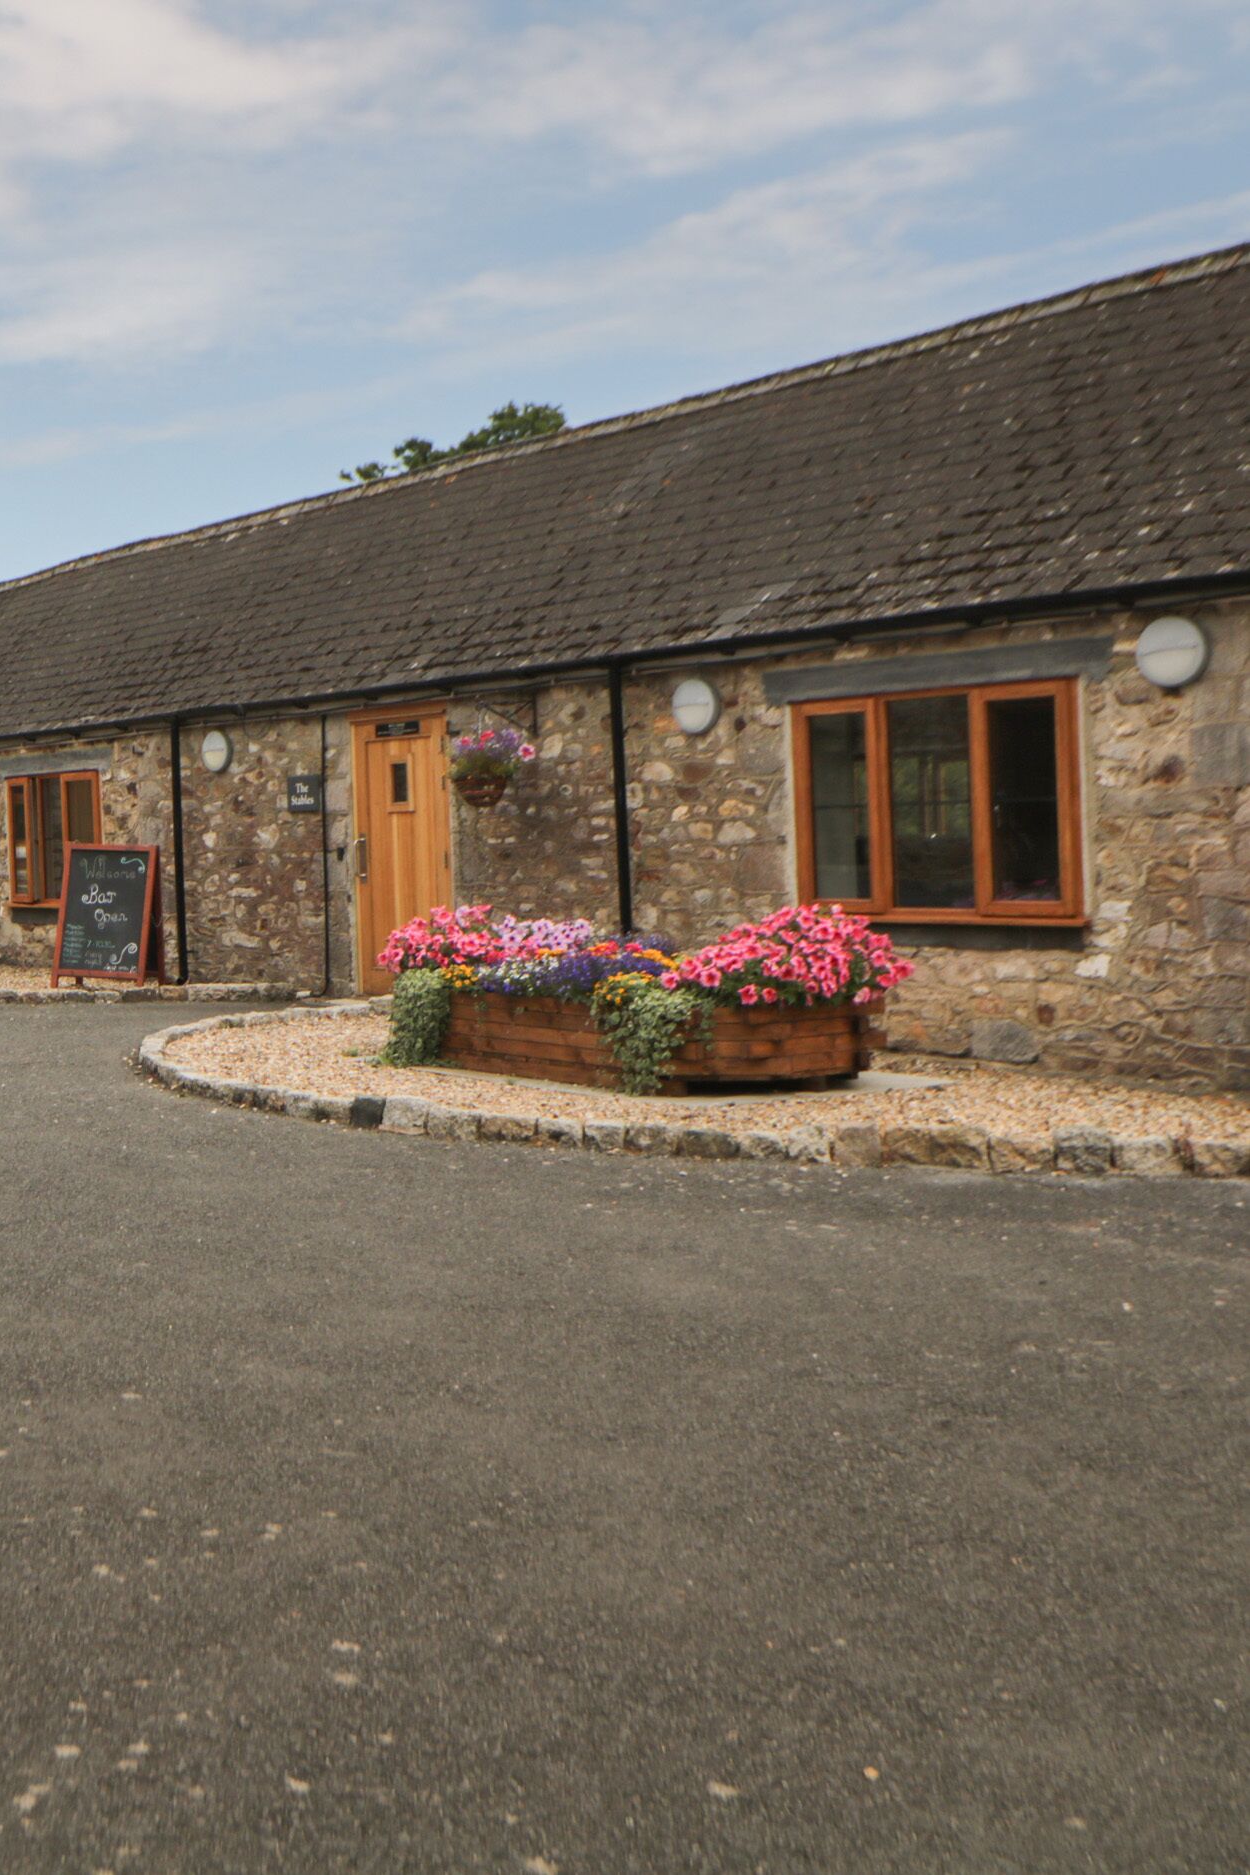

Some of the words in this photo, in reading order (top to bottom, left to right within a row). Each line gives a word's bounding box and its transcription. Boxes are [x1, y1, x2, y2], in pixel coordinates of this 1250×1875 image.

[294, 782, 309, 793] The
[291, 794, 315, 806] Stables
[79, 855, 136, 880] Welcome
[81, 883, 117, 905] Bar
[94, 907, 128, 930] Open
